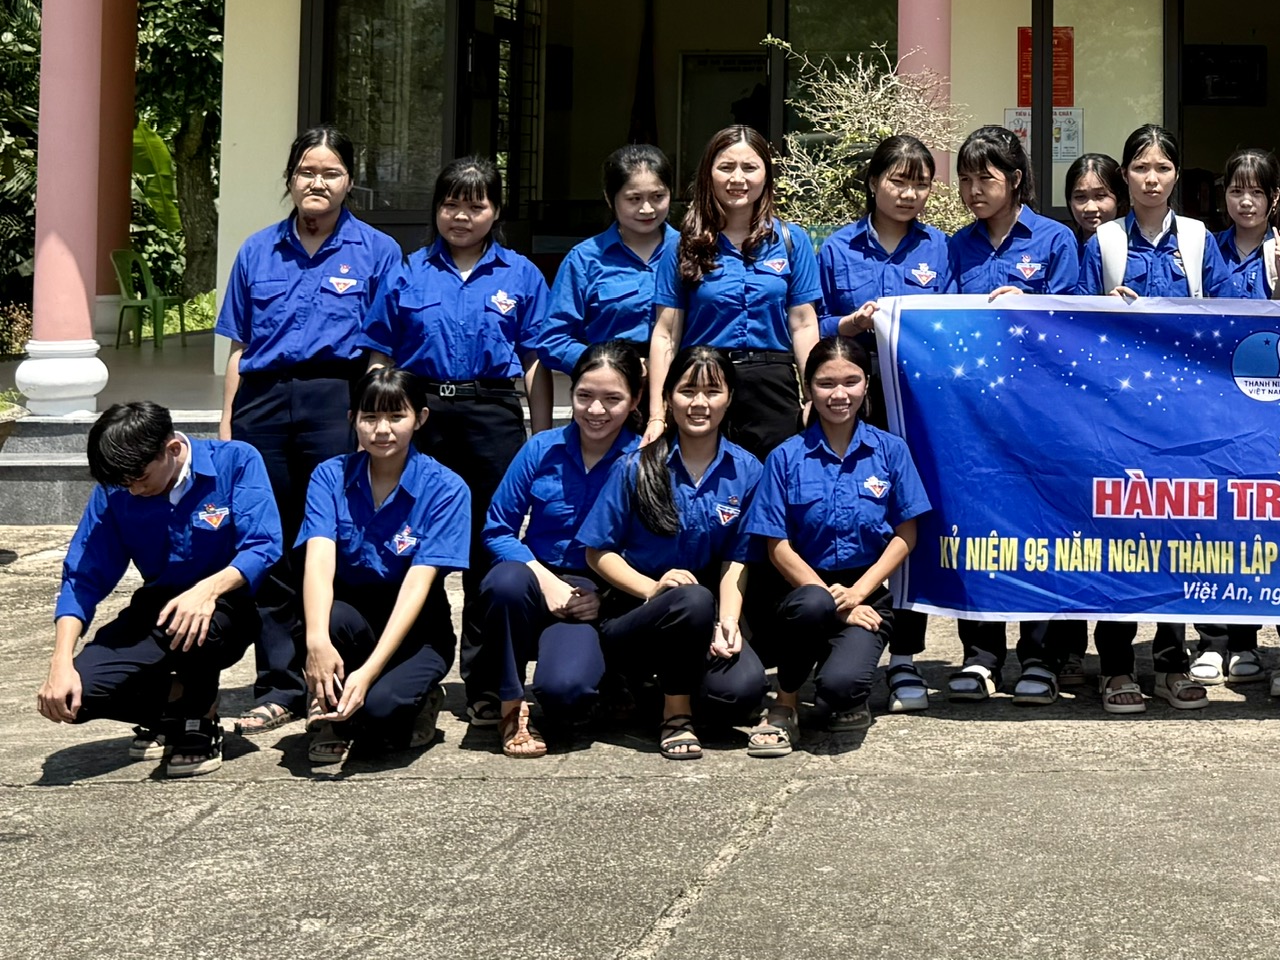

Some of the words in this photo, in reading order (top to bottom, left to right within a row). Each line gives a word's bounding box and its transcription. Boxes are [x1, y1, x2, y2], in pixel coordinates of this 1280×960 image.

[1093, 470, 1218, 519] HÀNH
[940, 525, 961, 569] KỶ
[965, 532, 1017, 578] NIỆM
[1025, 538, 1049, 571] 95
[1055, 530, 1101, 572] NĂM
[1108, 532, 1161, 573] NGÀY
[1168, 533, 1233, 574] THÀNH
[1240, 534, 1276, 582] LẬP
[1183, 581, 1218, 602] Việt
[1222, 583, 1253, 604] An,
